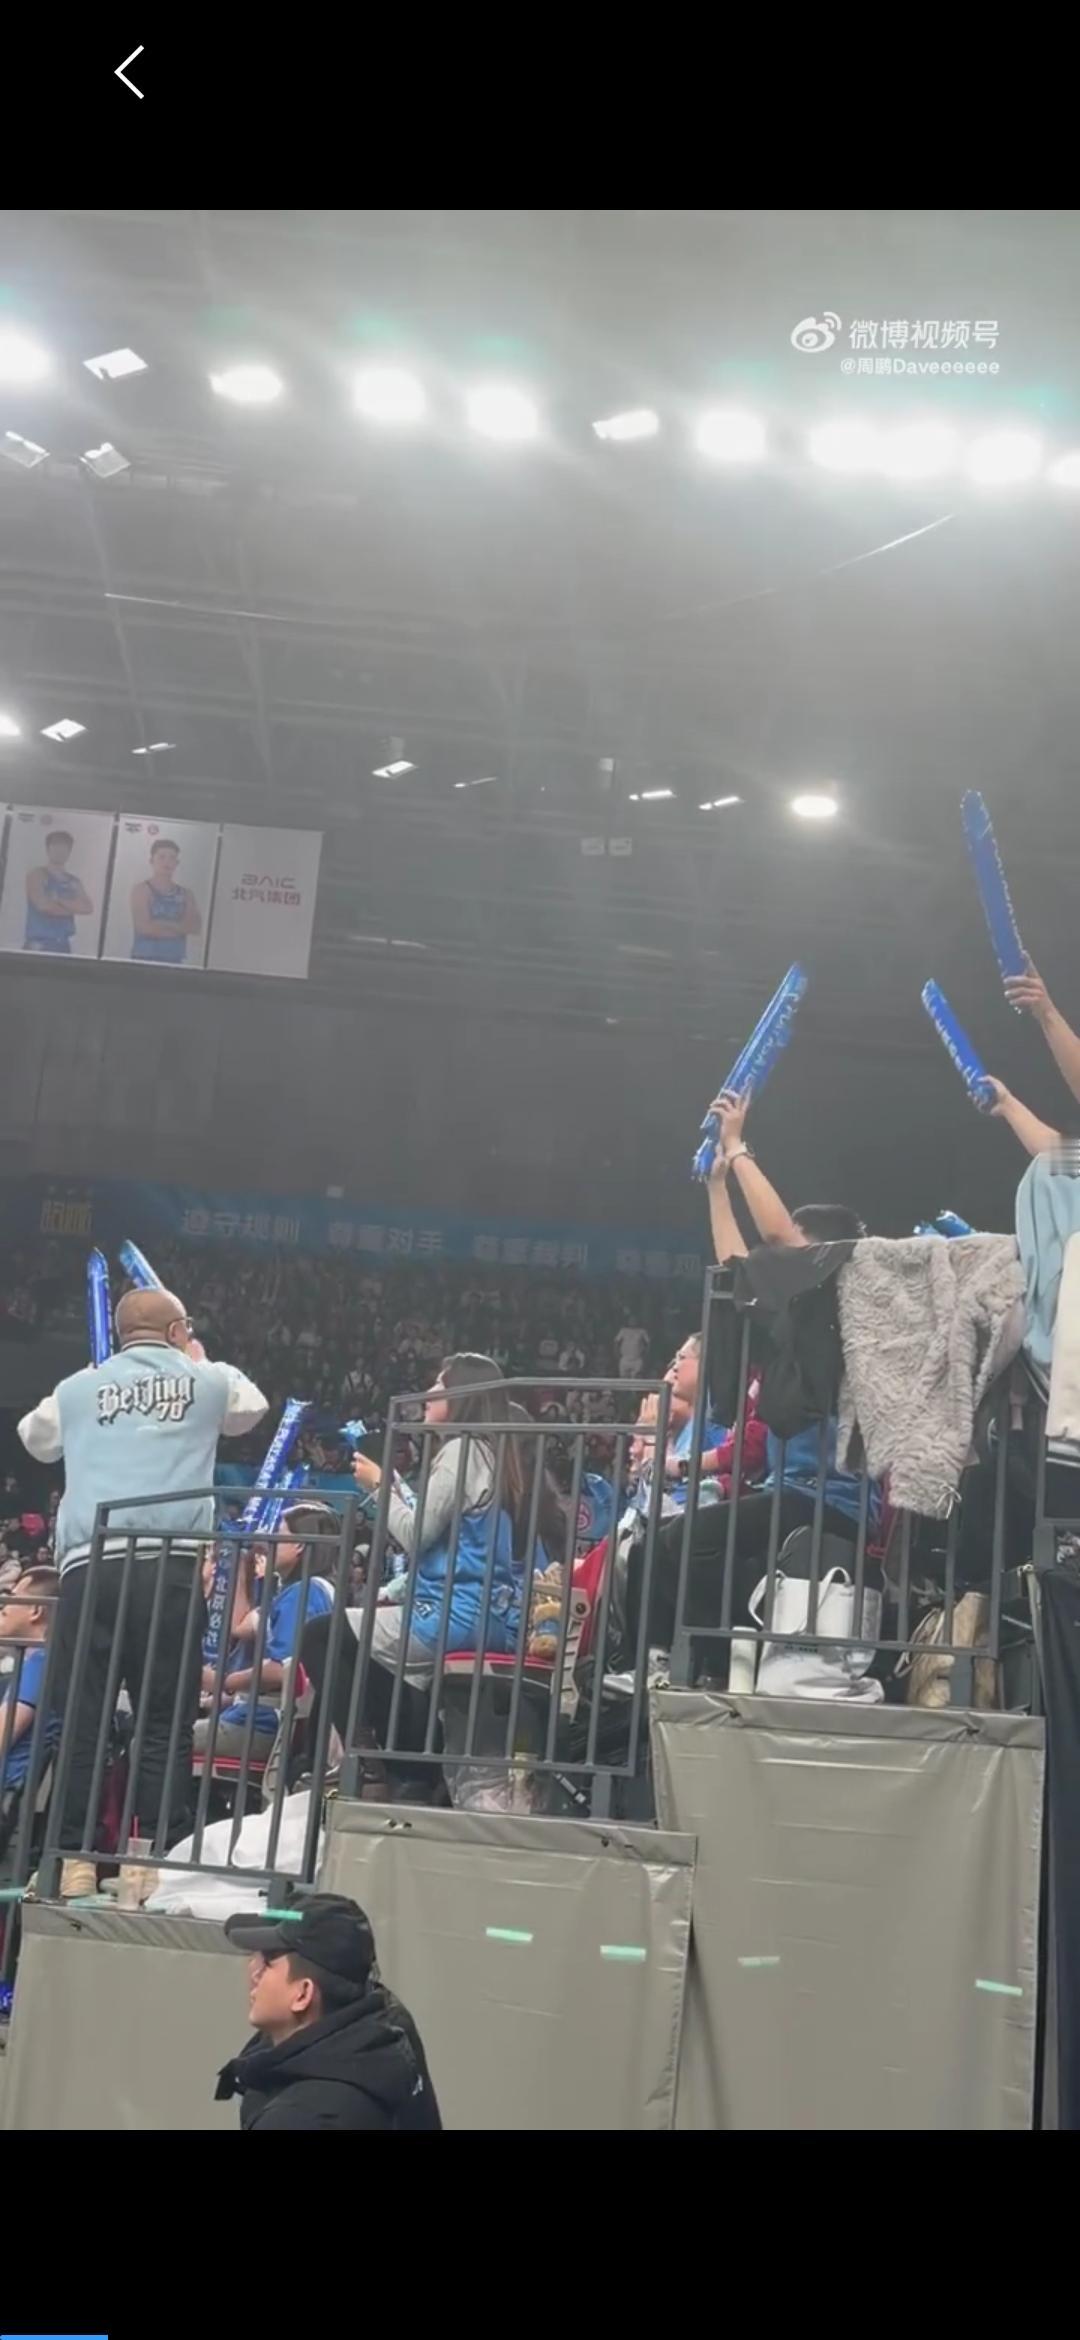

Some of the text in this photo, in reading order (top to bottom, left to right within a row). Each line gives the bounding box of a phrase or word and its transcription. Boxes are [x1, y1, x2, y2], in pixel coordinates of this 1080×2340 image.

[231, 886, 302, 907] 北汽集团
[155, 1400, 186, 1422] 70
